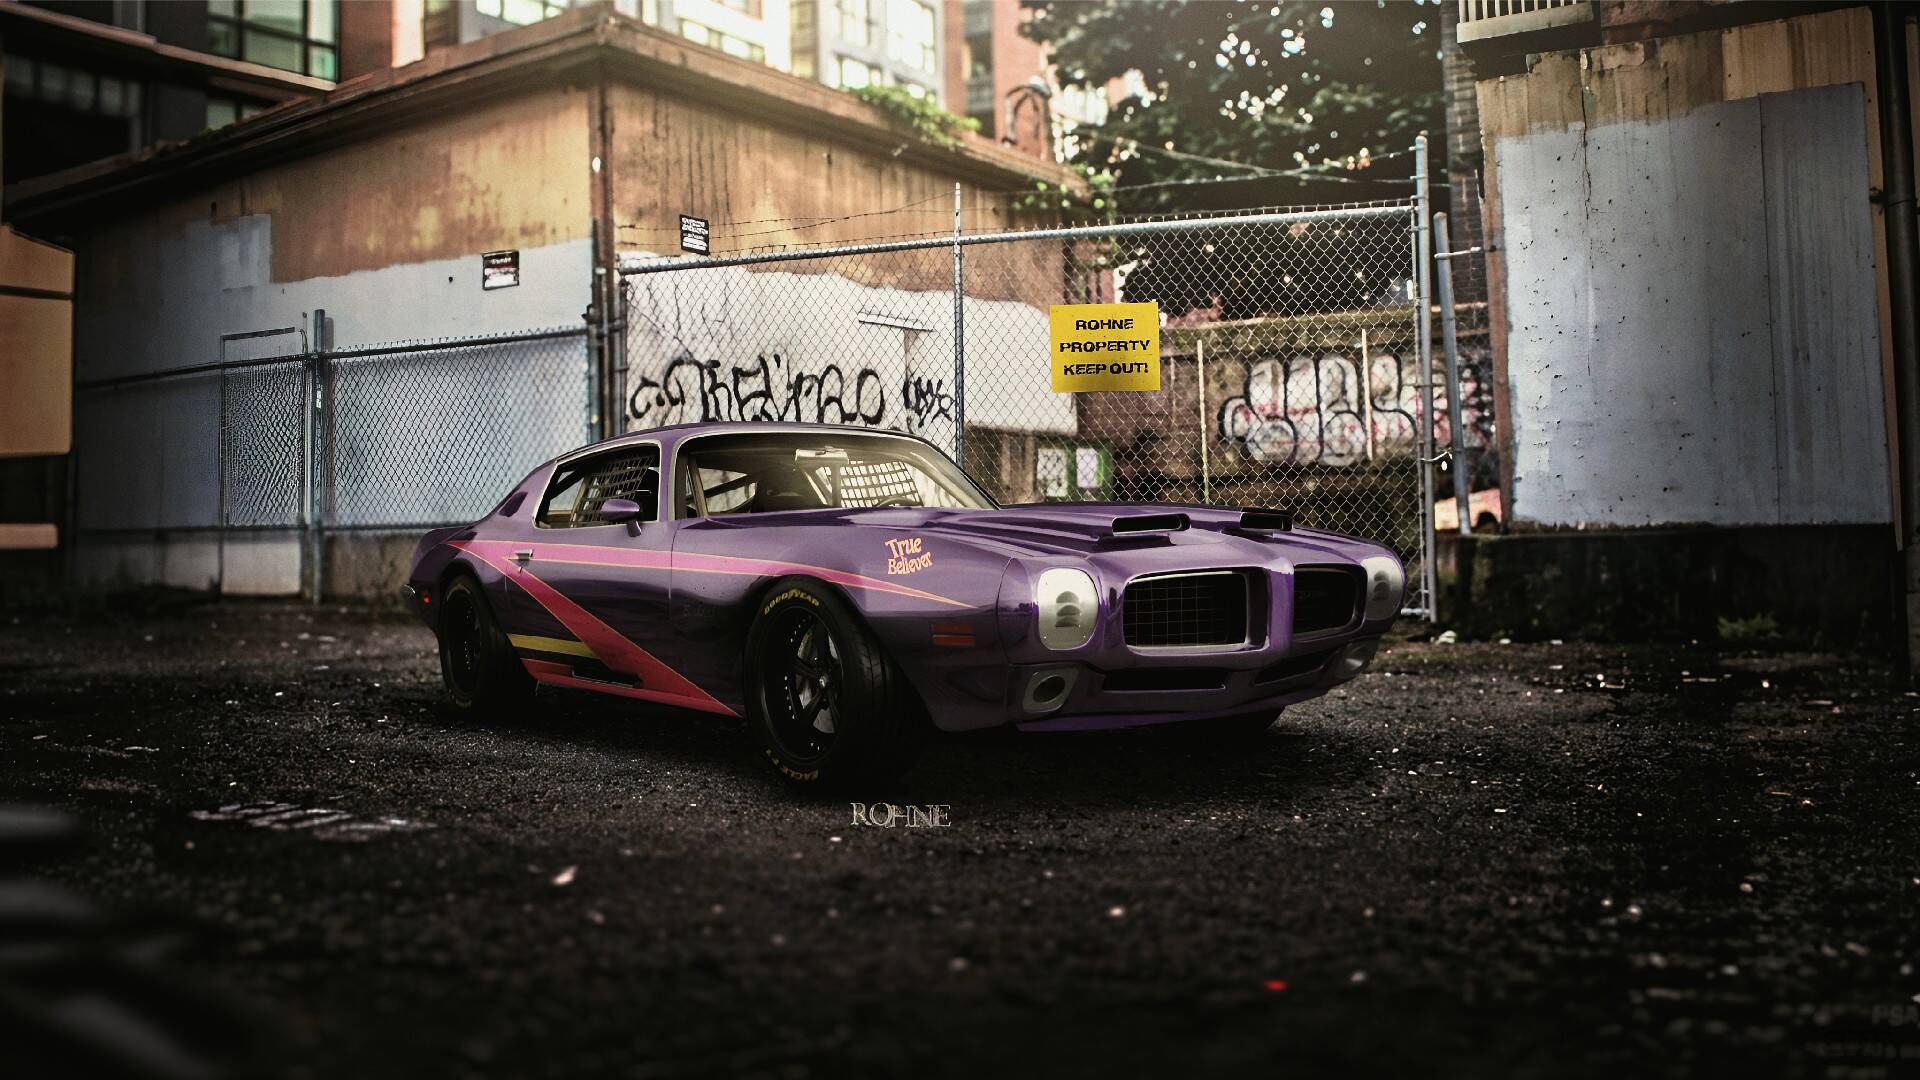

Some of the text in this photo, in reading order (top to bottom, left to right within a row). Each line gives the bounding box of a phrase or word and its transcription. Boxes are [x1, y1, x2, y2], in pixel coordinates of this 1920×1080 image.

[1075, 318, 1134, 331] ROHNE
[1059, 340, 1151, 353] PROPERTY
[1063, 362, 1149, 376] KEEP OUT!
[884, 537, 922, 559] True
[887, 551, 933, 575] Believer
[763, 588, 820, 615] GOODYEAR
